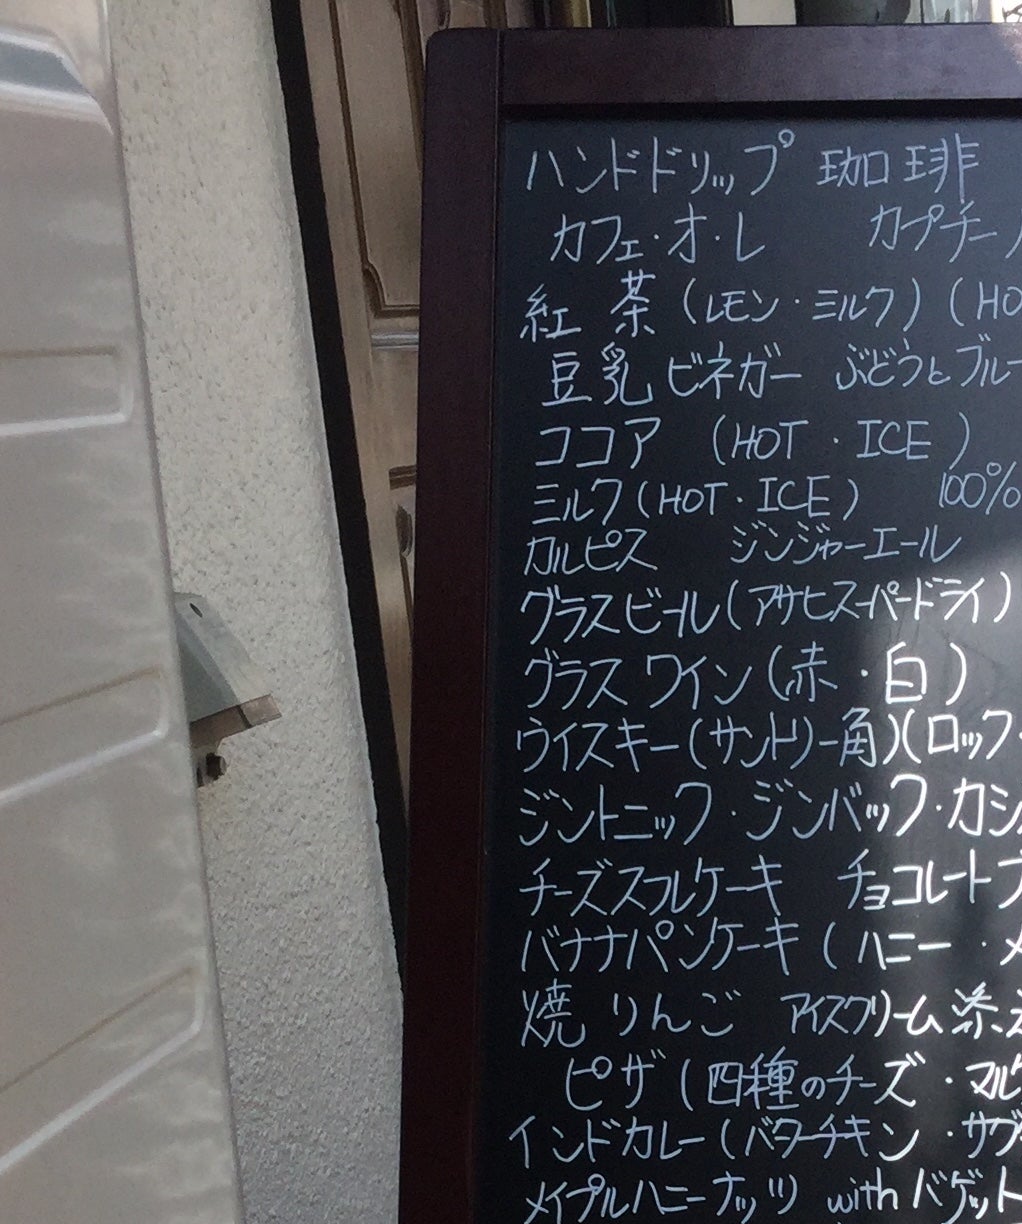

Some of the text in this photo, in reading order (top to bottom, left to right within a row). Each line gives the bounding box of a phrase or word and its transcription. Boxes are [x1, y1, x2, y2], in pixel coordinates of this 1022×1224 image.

[526, 129, 796, 195] ハンドドリップ
[535, 416, 662, 470] ココア
[523, 528, 659, 576] カルピス
[729, 520, 963, 565] ジンジャーエール
[826, 1165, 899, 1214] with
